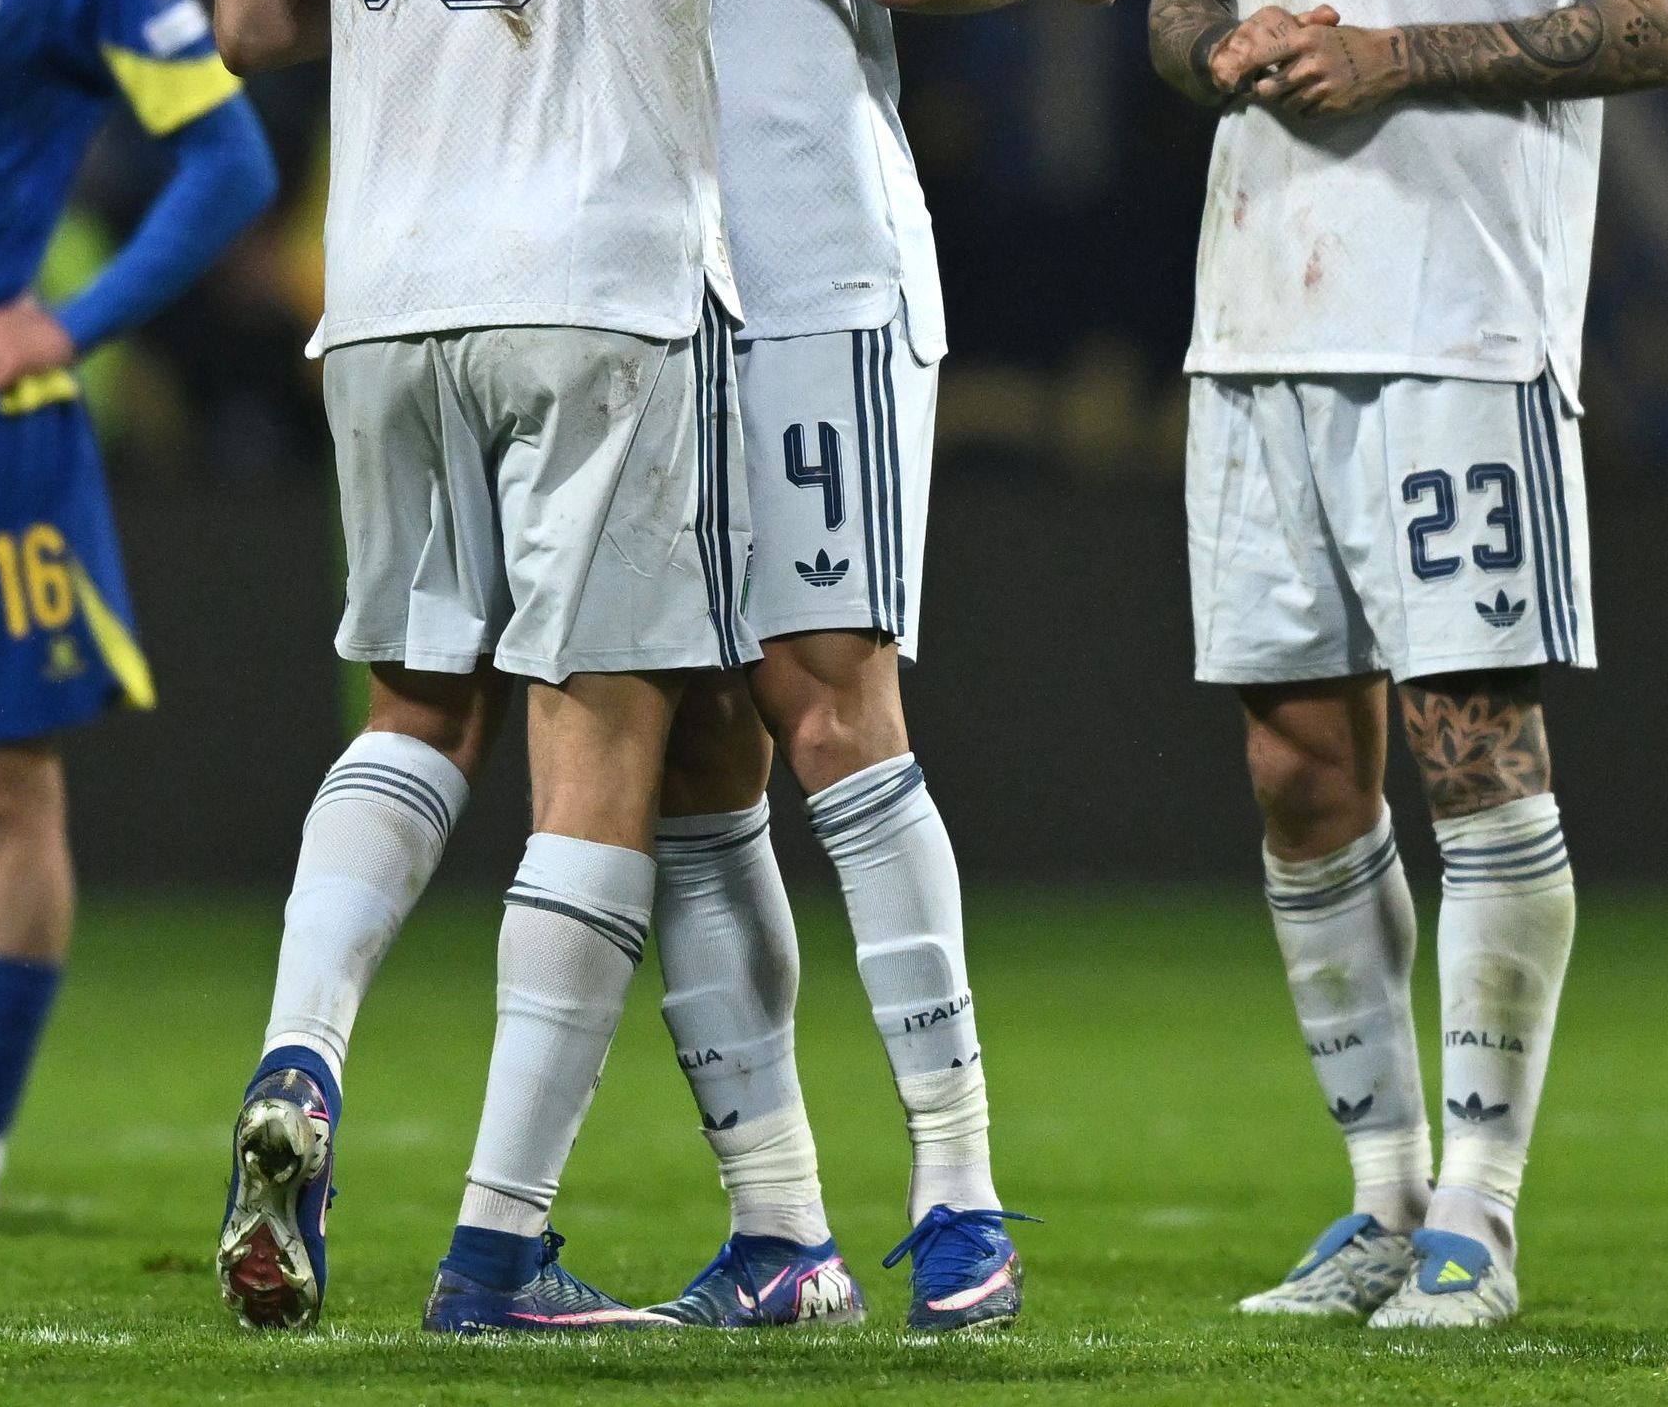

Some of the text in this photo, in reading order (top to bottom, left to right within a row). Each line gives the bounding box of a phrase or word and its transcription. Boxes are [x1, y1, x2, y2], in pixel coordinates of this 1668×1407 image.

[783, 421, 846, 532] 4
[1401, 462, 1526, 582] 23
[904, 993, 971, 1033] ITALIA
[1445, 1030, 1524, 1054] ITALIA
